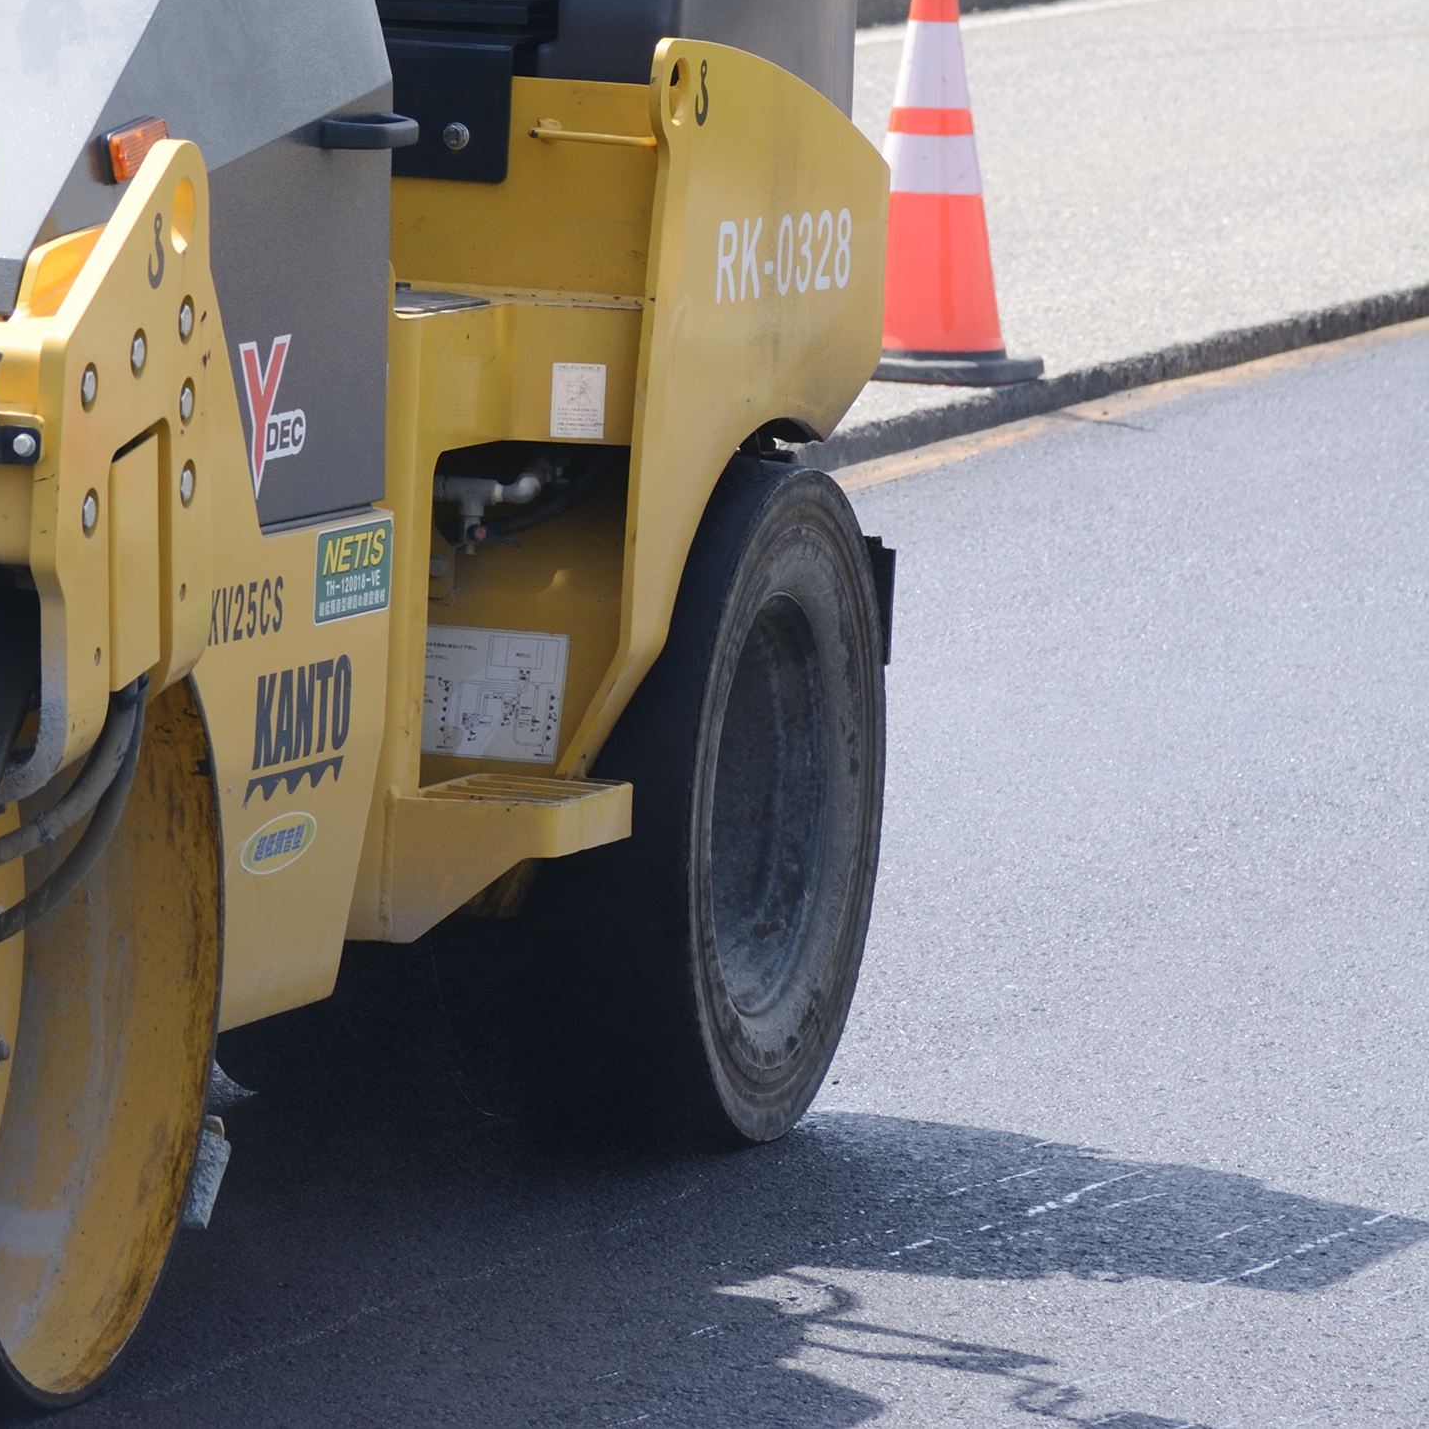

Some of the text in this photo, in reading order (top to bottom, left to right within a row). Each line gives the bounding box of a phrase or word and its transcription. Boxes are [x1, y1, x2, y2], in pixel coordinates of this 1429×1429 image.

[716, 207, 852, 304] RK-0328
[266, 416, 304, 453] DEC
[322, 527, 387, 577] NETIS
[207, 575, 284, 647] KV25CS
[325, 569, 381, 597] TH-120018-VE
[252, 654, 352, 770] KANTO
